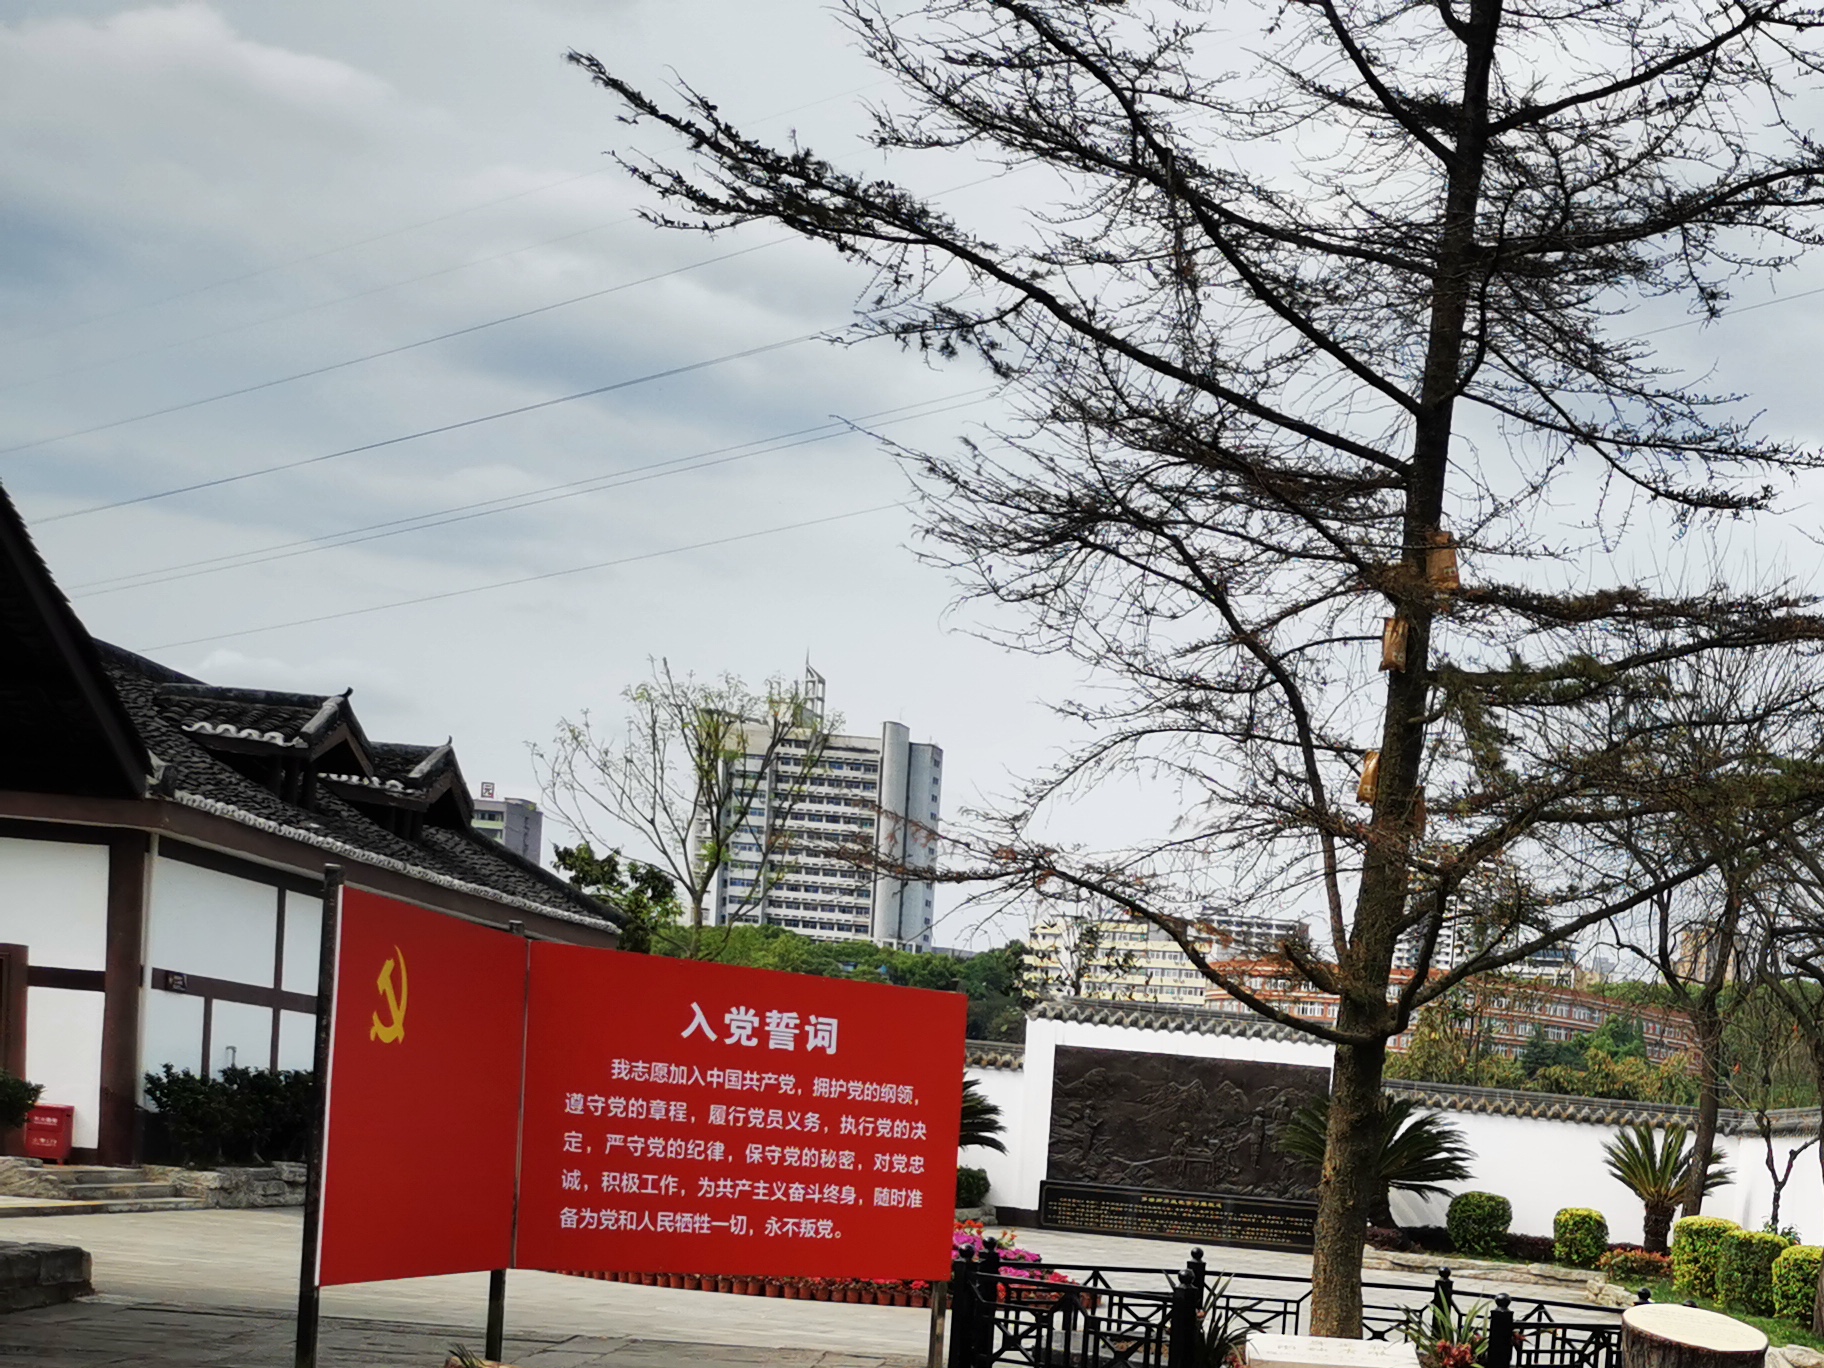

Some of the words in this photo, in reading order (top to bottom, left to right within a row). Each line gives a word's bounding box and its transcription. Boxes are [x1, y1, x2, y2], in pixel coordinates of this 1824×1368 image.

[681, 1001, 839, 1056] 入党誓词
[611, 1058, 920, 1106] 我志愿加入中国共产党，拥护党的纲领，
[564, 1092, 927, 1141] 遵守党的章程，履行党员义务，执行党的决
[563, 1130, 925, 1174] 定，严守党的纪律，保守党的秘密，对党忠
[561, 1169, 923, 1209] 诚，积极工作，为共产主义奋斗终身，随时准
[560, 1206, 842, 1239] 备为党和人民牺牲一切，永不叛党。
